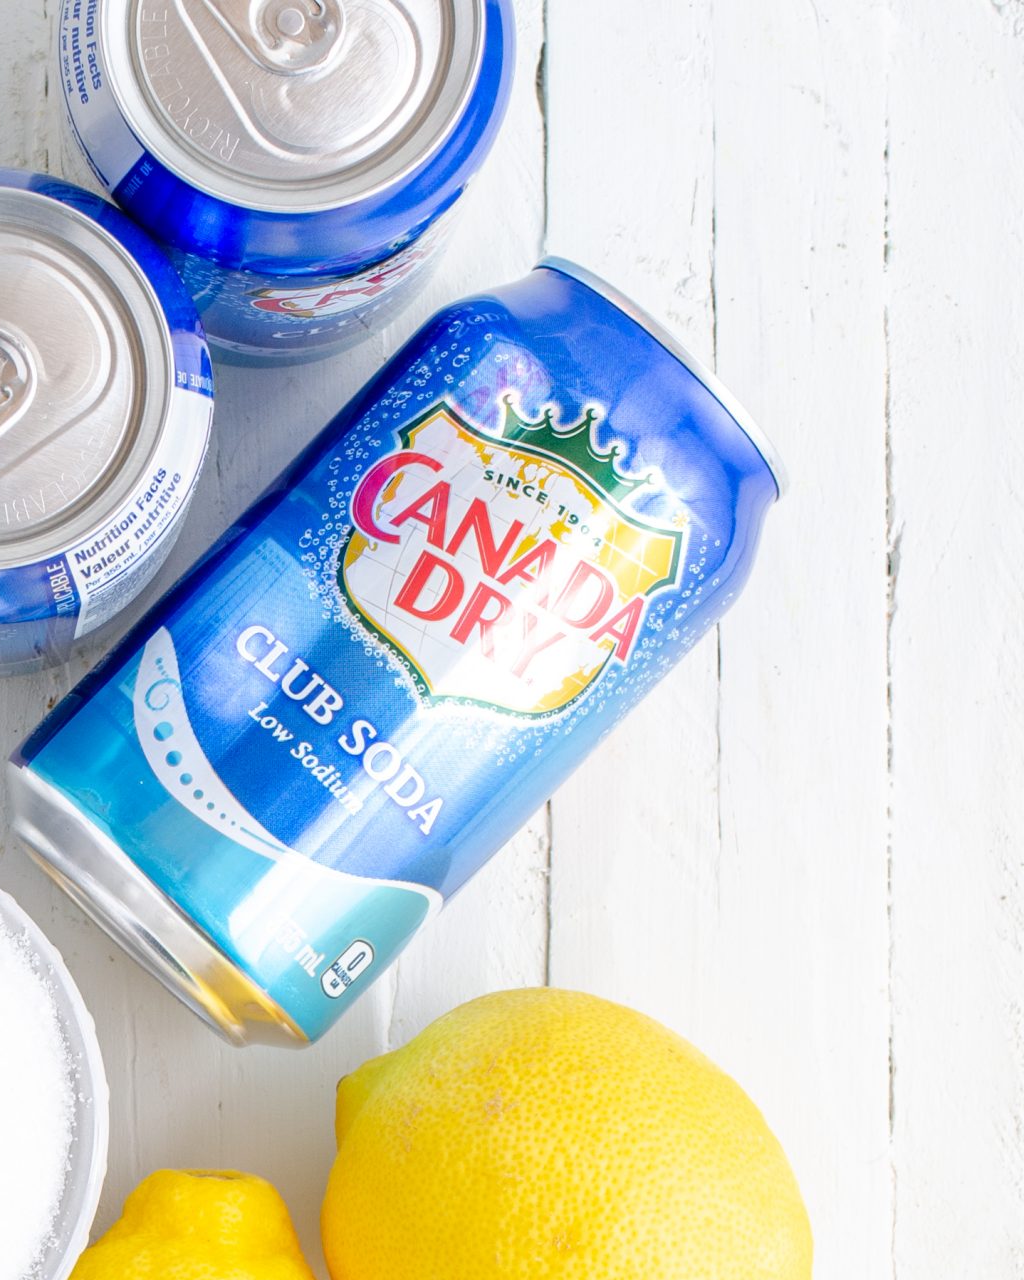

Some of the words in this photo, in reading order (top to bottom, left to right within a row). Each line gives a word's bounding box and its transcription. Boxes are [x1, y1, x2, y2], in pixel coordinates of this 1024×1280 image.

[86, 0, 97, 38] ition
[72, 26, 89, 105] nutritive
[87, 41, 102, 91] Facts
[139, 160, 154, 176] DE
[74, 511, 138, 565] Nutrition
[135, 467, 167, 512] Facts
[80, 538, 131, 579] Valeur
[133, 472, 182, 541] nutritive
[483, 469, 548, 505] SINCE
[85, 577, 102, 590] Per
[103, 563, 122, 579] 355
[350, 451, 646, 663] CANADA
[393, 549, 567, 680] DRY
[235, 625, 344, 726] CLUB
[337, 719, 445, 836] SODA
[247, 700, 295, 743] Low
[290, 741, 364, 816] Sodium
[347, 951, 366, 972] 0
